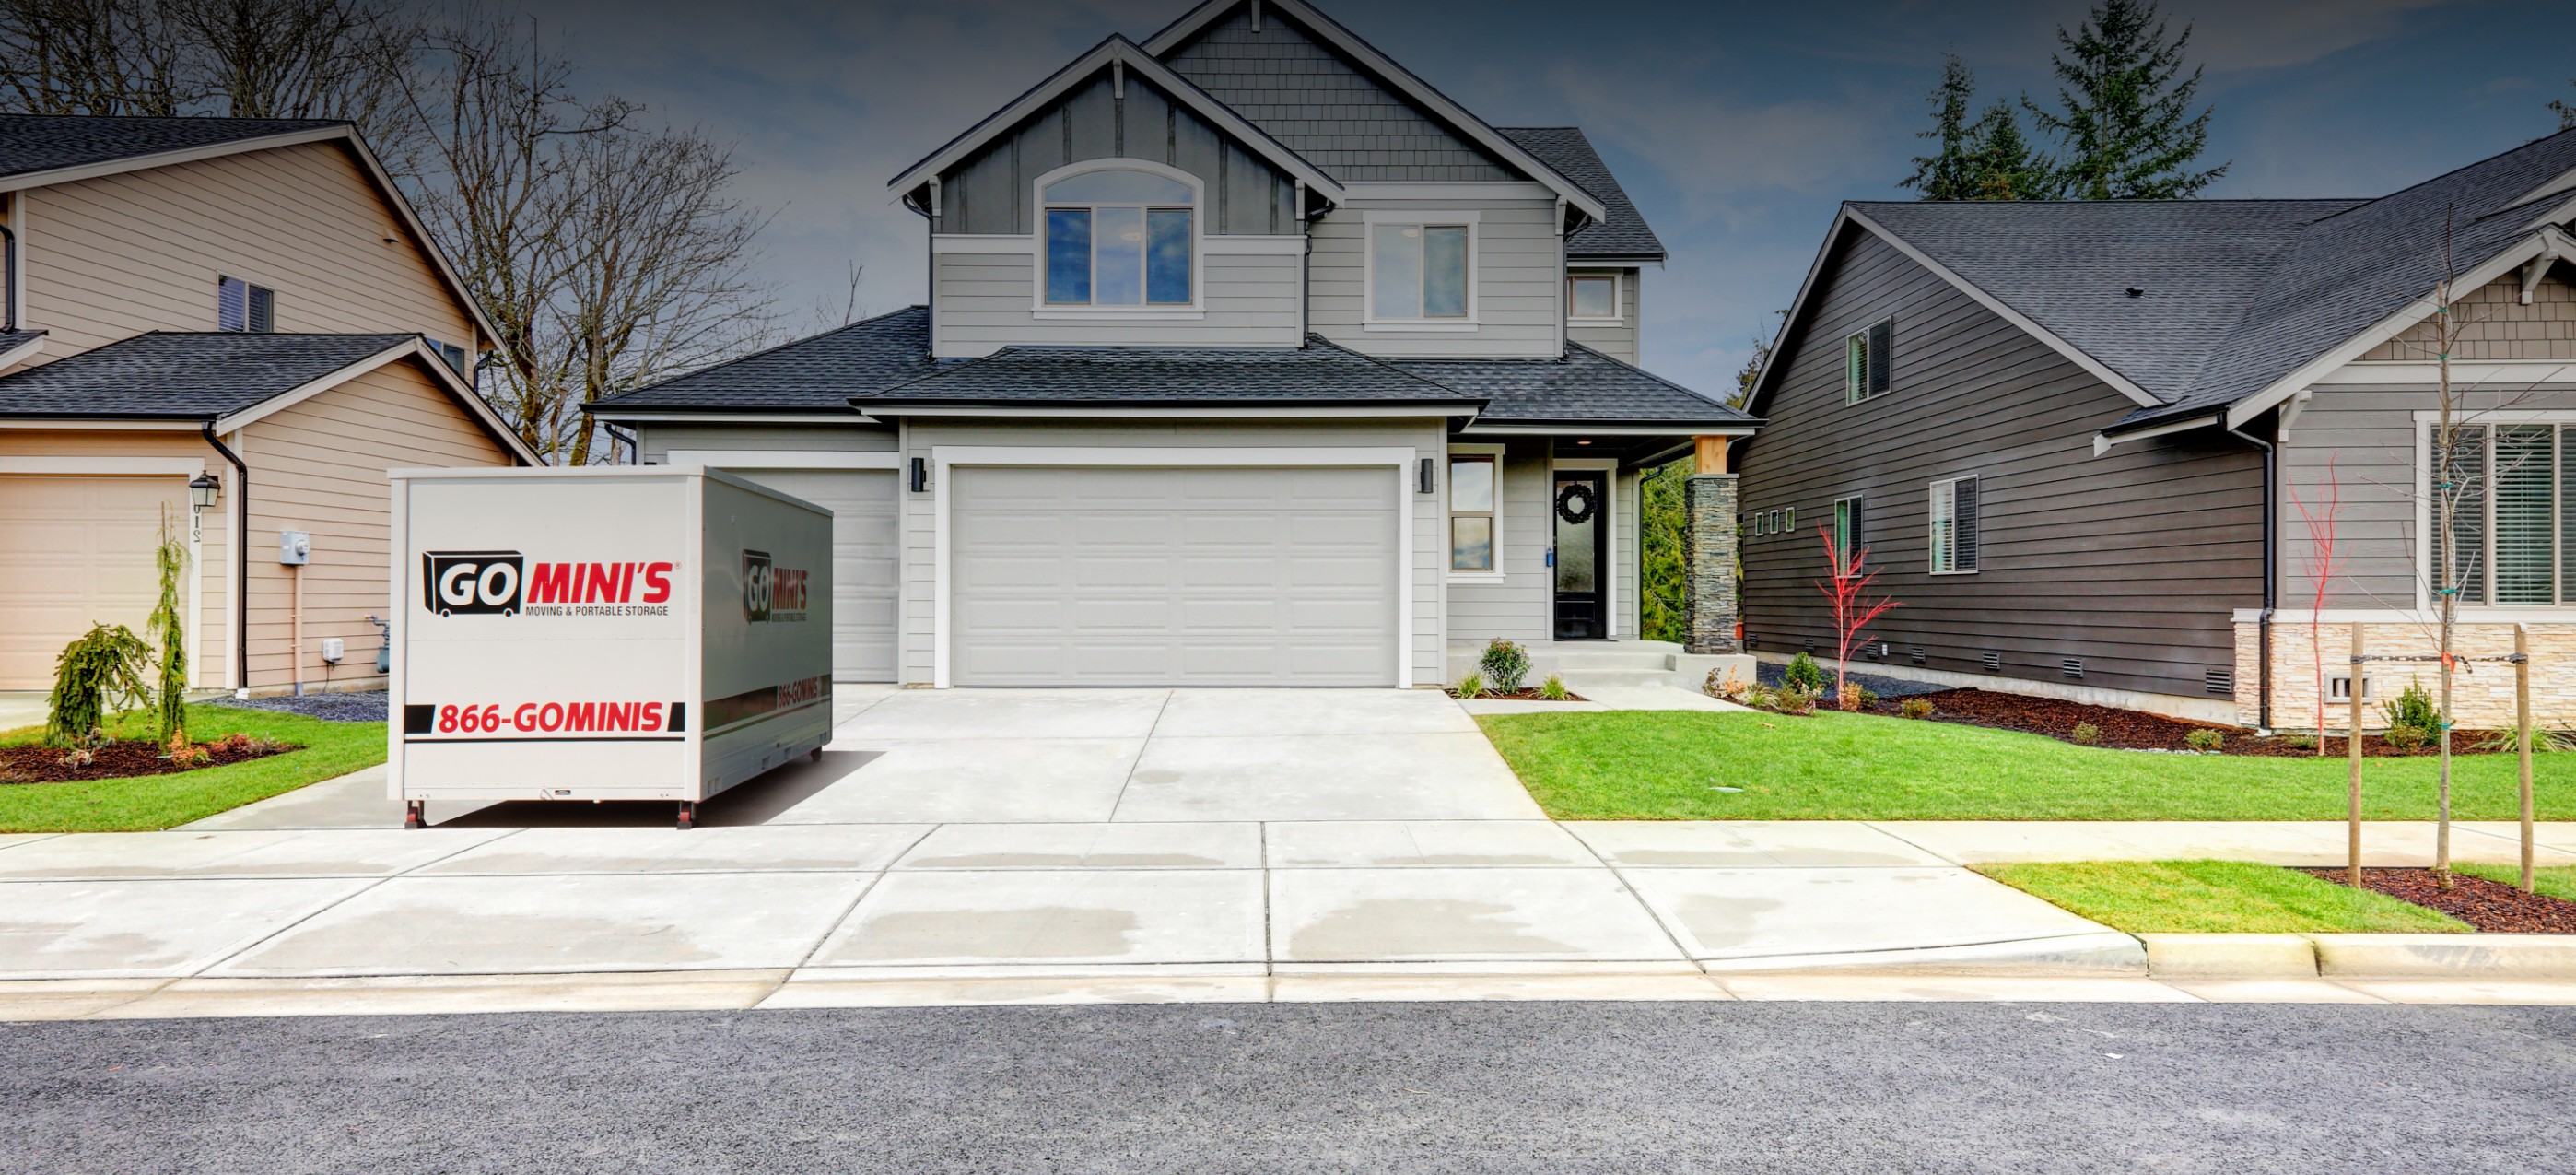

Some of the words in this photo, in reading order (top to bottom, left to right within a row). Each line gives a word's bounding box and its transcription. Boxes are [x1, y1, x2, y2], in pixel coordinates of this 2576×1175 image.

[439, 562, 517, 605] GO
[747, 565, 770, 612] GO
[526, 605, 563, 617] MOVING
[566, 605, 573, 617] &
[576, 605, 623, 617] PORTABLE
[626, 605, 669, 617] STORAGE
[439, 701, 663, 734] 866-GOMINIS
